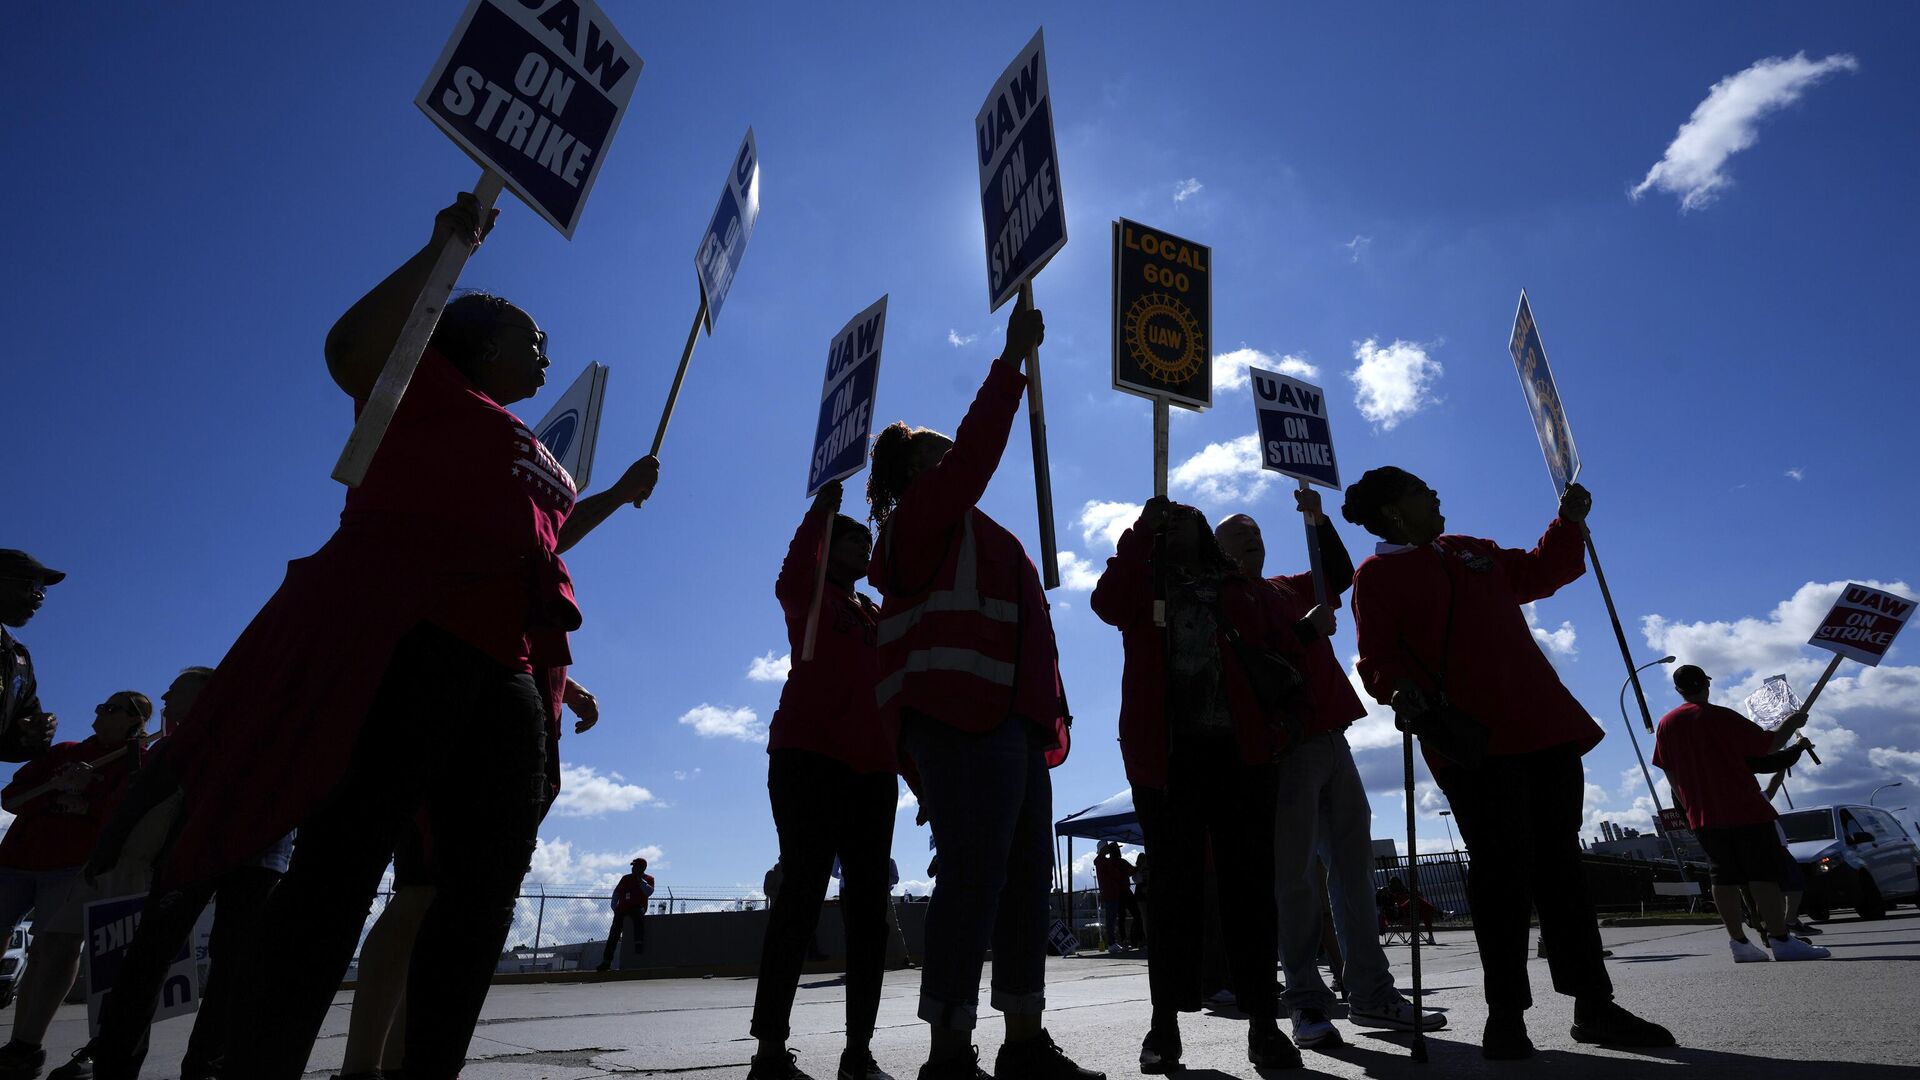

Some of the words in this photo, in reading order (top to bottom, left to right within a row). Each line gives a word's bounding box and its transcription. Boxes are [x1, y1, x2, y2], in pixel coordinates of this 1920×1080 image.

[514, 52, 576, 118] ON
[442, 65, 592, 188] STRIKE
[980, 51, 1039, 166] UAW
[1002, 141, 1028, 212] ON
[991, 158, 1054, 290] STRIKE
[1125, 227, 1206, 272] LOCAL
[1143, 263, 1189, 292] 600
[827, 312, 881, 382] UAW
[1150, 325, 1182, 349] UAW
[832, 375, 855, 426] ON
[1256, 376, 1320, 415] UAW
[812, 398, 869, 484] STRIKE
[1283, 417, 1309, 440] ON
[1268, 440, 1332, 466] STRIKE
[1846, 588, 1910, 617] UAW
[1846, 613, 1878, 628] ON
[1815, 625, 1893, 646] STRIKE
[93, 911, 142, 957] IKE
